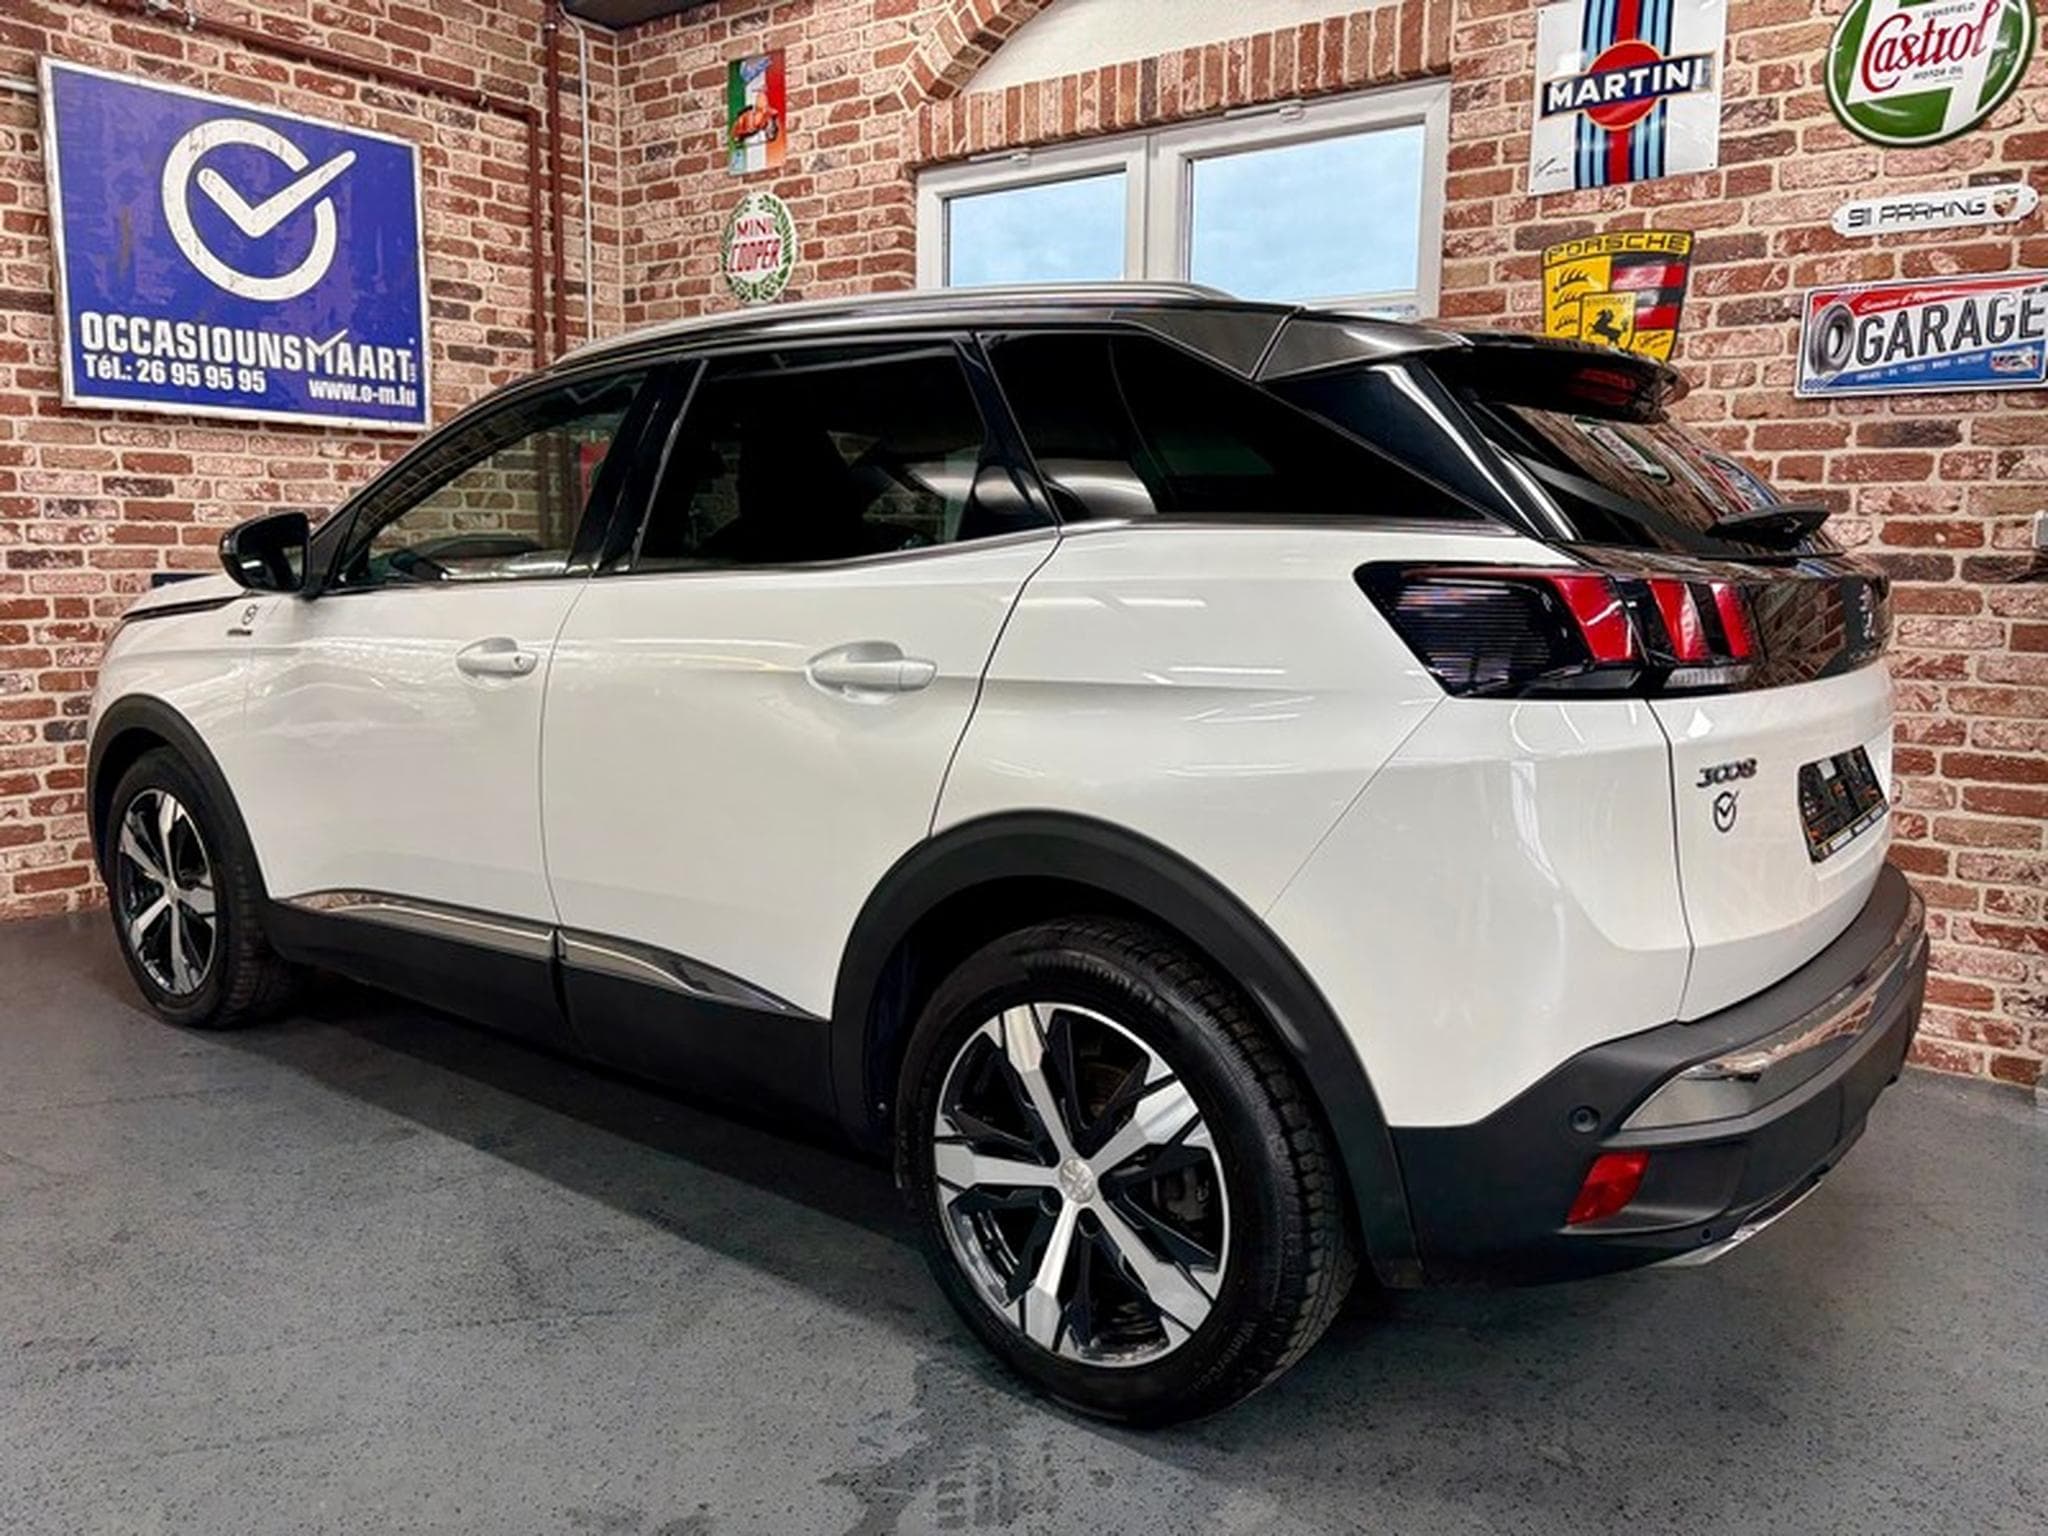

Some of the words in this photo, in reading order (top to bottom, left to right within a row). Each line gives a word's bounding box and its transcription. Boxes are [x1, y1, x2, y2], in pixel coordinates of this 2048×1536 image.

[1861, 0, 2000, 93] Castrol
[1548, 59, 1703, 111] MARTINI
[736, 217, 775, 238] MINI
[1879, 197, 1986, 225] PARKING
[730, 238, 780, 272] COOPER
[1548, 234, 1687, 263] PORSCHE
[1856, 292, 2045, 366] GARAGE
[80, 311, 411, 382] OCCASIOUNSMAART
[83, 353, 132, 381] Tél.:
[136, 358, 167, 384] 26
[171, 361, 200, 387] 95
[204, 365, 234, 390] 95
[238, 368, 266, 393] 95
[308, 379, 417, 407] www.o-m.lu
[1696, 758, 1757, 788] 3008
